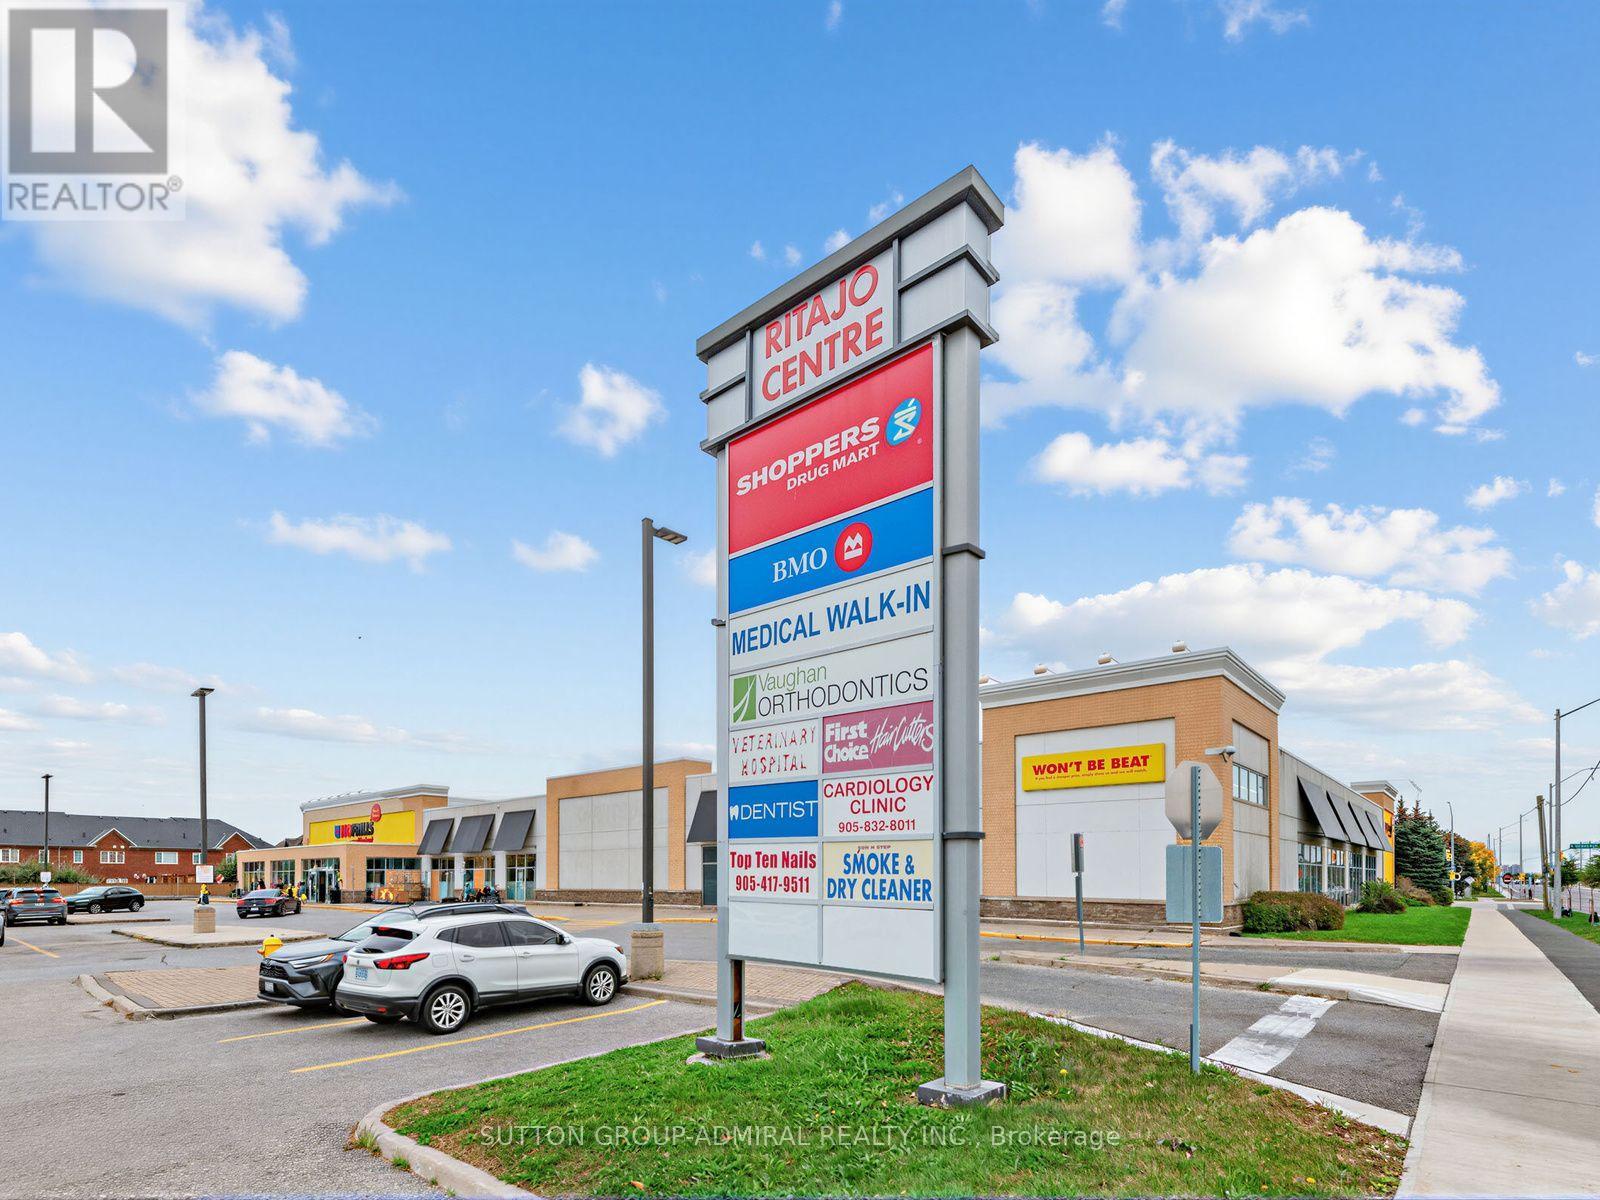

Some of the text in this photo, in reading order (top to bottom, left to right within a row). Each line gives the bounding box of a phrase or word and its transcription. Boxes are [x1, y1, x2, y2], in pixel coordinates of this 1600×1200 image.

[765, 264, 879, 360] RITAJO
[761, 307, 883, 402] CENTRE
[735, 416, 881, 497] SHOPPERS
[786, 441, 880, 491] DRUG MART
[771, 547, 828, 584] BMO
[731, 580, 931, 656] MEDICAL WALK-IN
[758, 665, 827, 694] Vaughan
[758, 667, 929, 717] ORTHODONTICS
[732, 726, 816, 754] VETERINARY
[825, 720, 868, 743] First
[741, 754, 807, 776] HOSPITAL
[824, 744, 869, 763] Choice
[1032, 755, 1149, 776] WON'T BE BEAT
[823, 775, 934, 799] CARDIOLOGY
[740, 801, 818, 820] DENTIST
[850, 796, 906, 815] CLINIC
[838, 819, 916, 833] 905-832-8011
[730, 850, 817, 869] Top Ten Nails
[843, 853, 915, 875] SMOKE &
[735, 875, 810, 893] 905-417-9511
[827, 878, 933, 902] DRY CLEANER
